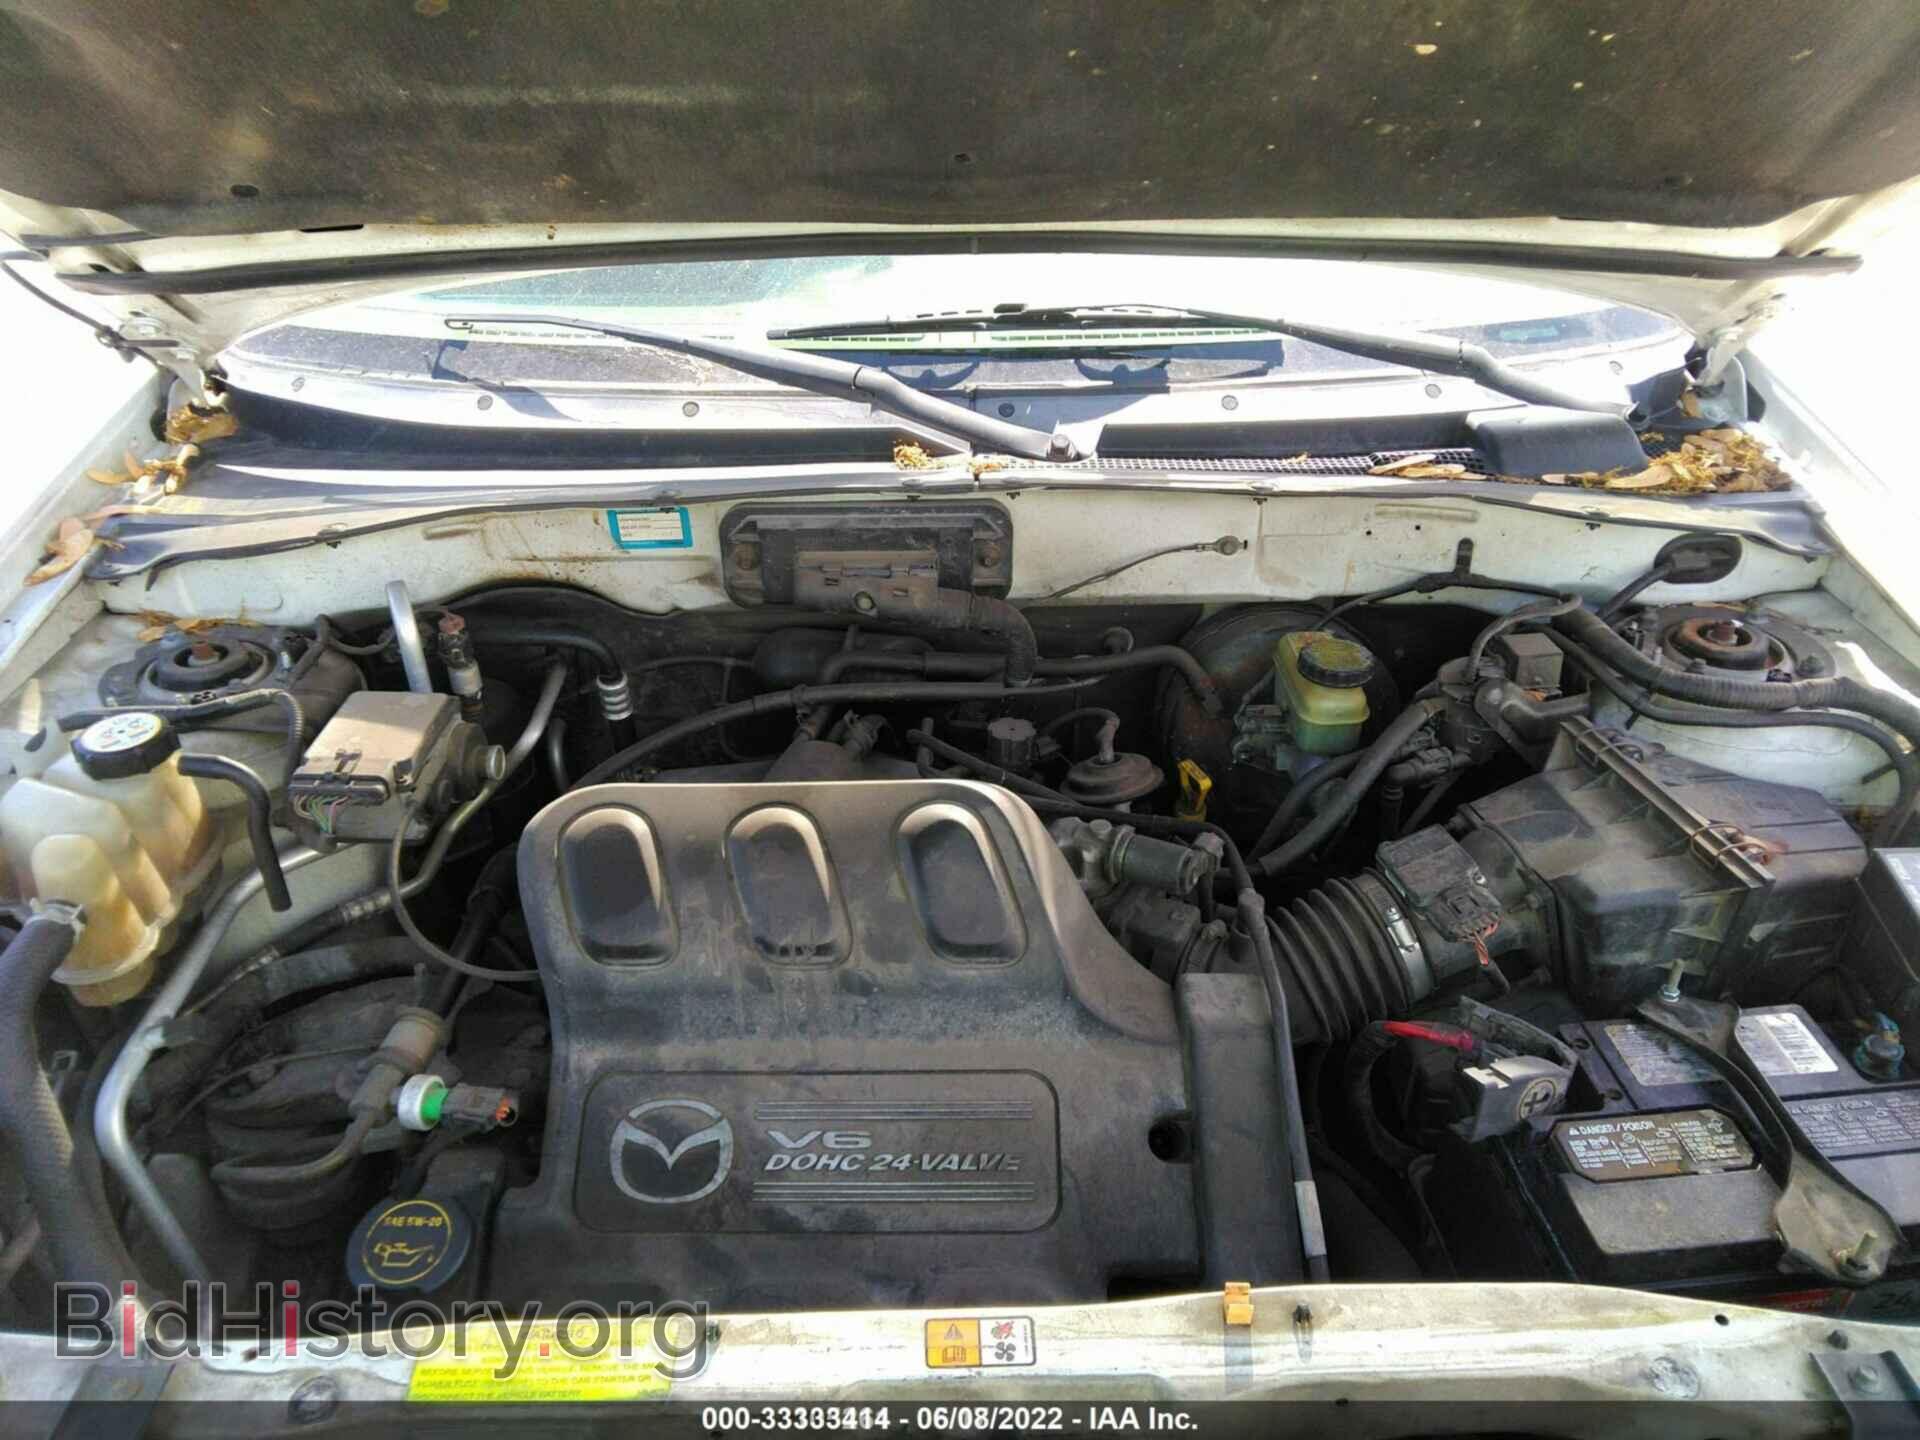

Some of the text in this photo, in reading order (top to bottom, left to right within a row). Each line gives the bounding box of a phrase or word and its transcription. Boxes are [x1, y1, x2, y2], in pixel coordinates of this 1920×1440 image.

[1578, 1124, 1615, 1135] DANGER
[767, 1130, 872, 1149] V6
[764, 1153, 1021, 1171] DOHC 24-VALVE
